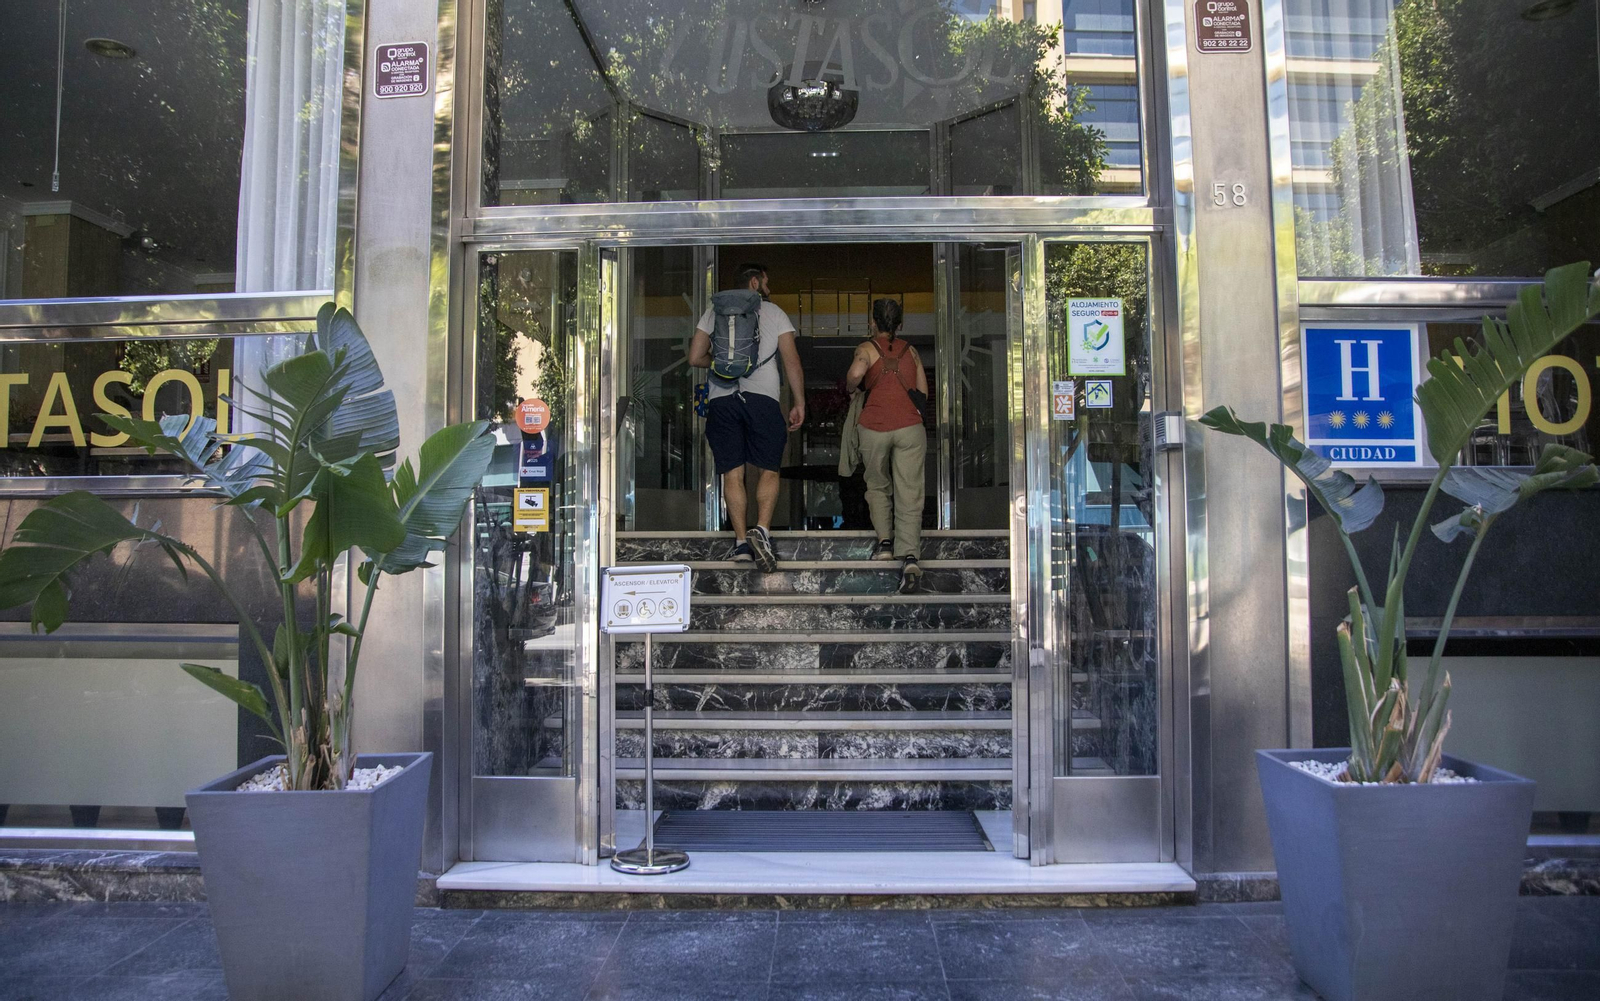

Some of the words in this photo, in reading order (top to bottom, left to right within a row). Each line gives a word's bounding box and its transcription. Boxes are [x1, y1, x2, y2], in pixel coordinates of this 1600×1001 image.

[1213, 183, 1247, 206] 58
[1334, 340, 1385, 401] H
[1330, 447, 1396, 460] CIUDAD
